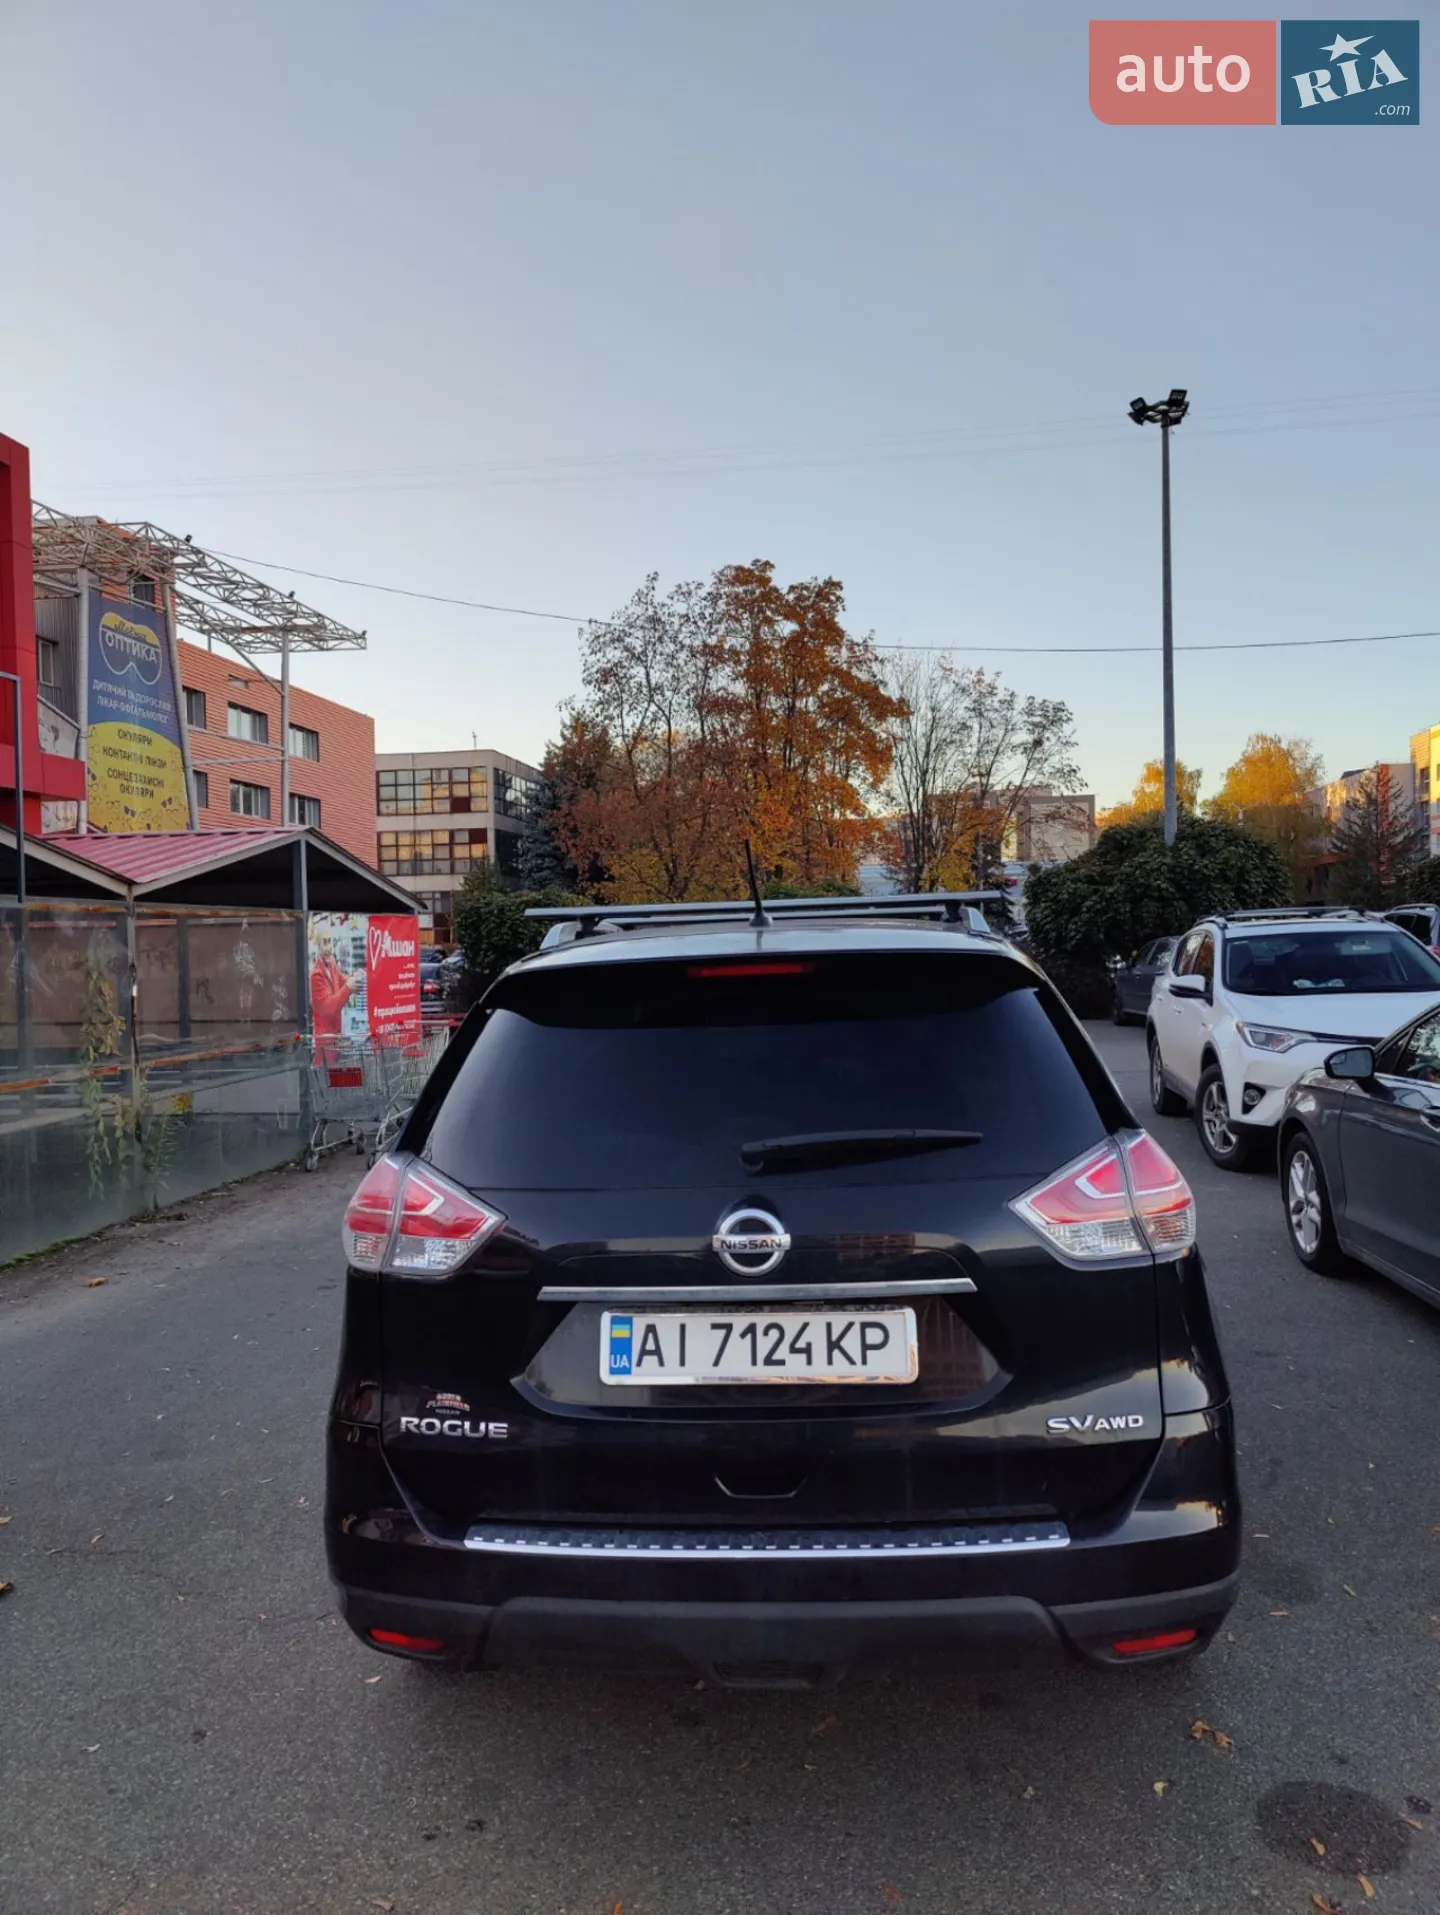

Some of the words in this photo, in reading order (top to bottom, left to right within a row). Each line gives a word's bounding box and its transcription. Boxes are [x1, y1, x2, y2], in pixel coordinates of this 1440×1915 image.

[105, 631, 158, 664] ОПТИКА
[117, 728, 153, 747] ОКУЛЯРИ
[102, 745, 144, 765] КОНТАКТНІ
[107, 767, 165, 788] СОНЦЕЗАХИСНІ
[119, 783, 154, 800] ОКУЛЯРИ
[381, 930, 415, 958] Ашан
[719, 1238, 783, 1251] NISSAN
[635, 1322, 686, 1368] AI
[710, 1321, 813, 1367] 7124
[825, 1320, 891, 1366] KP
[610, 1354, 630, 1369] UA
[399, 1416, 509, 1439] ROGUE
[1046, 1414, 1094, 1435] SV
[1094, 1414, 1145, 1431] AWD
